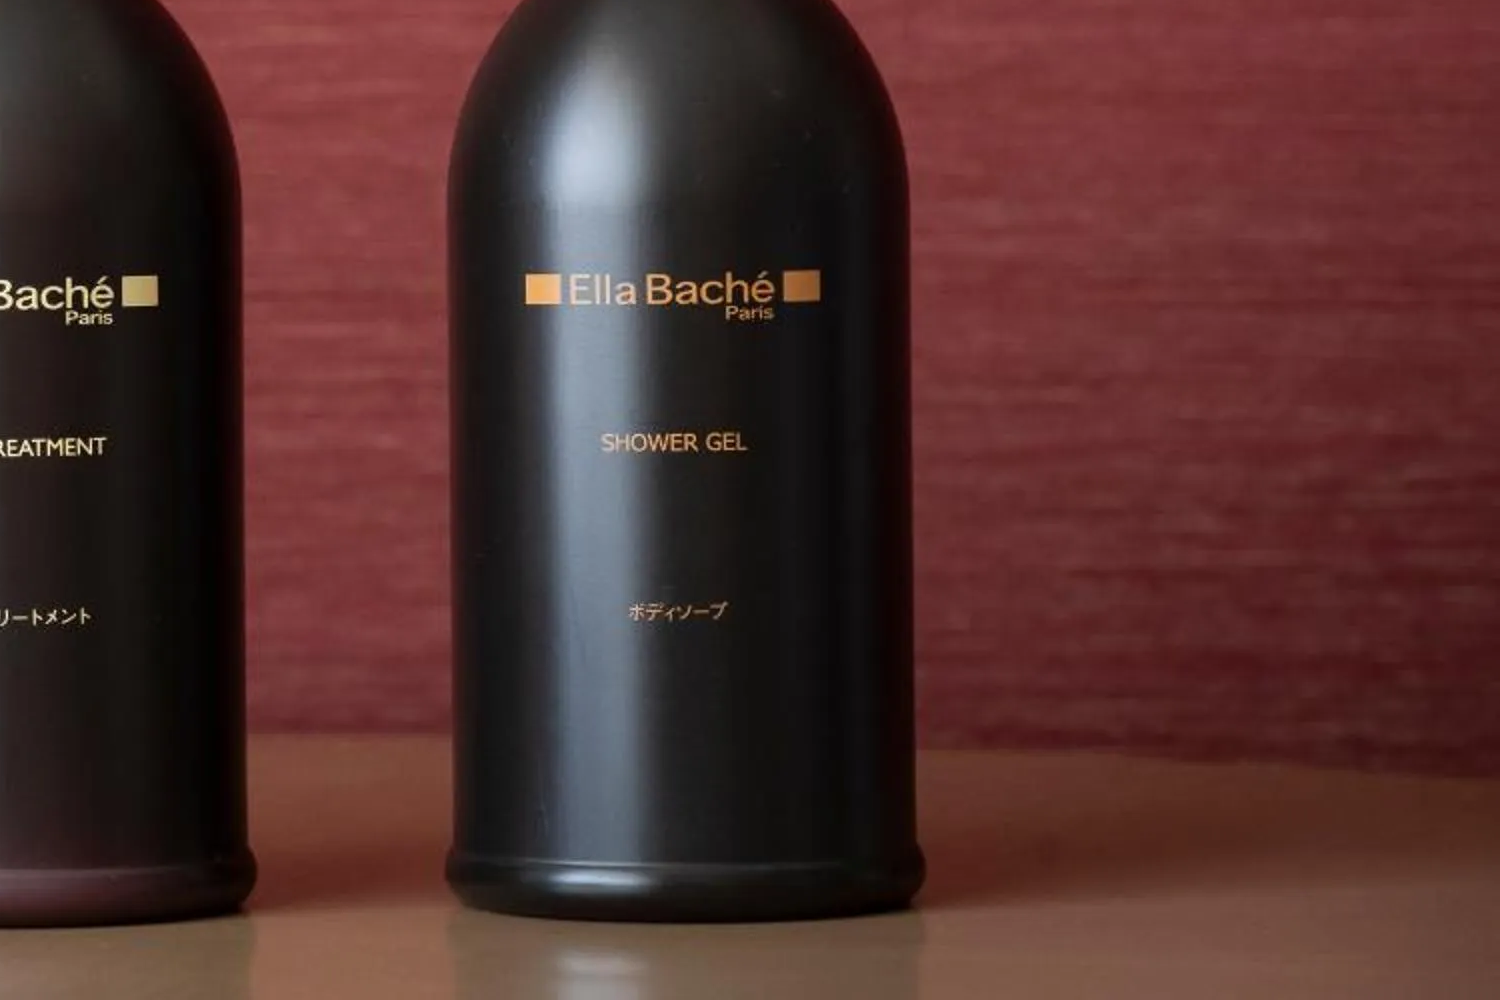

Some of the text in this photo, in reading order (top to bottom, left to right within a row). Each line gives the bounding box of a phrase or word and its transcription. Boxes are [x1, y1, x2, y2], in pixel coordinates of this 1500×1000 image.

[569, 270, 776, 306] Ella Baché
[64, 310, 115, 327] Paris
[725, 304, 775, 322] Paris
[601, 431, 748, 453] SHOWER GEL
[628, 601, 730, 623] ボディソープ
